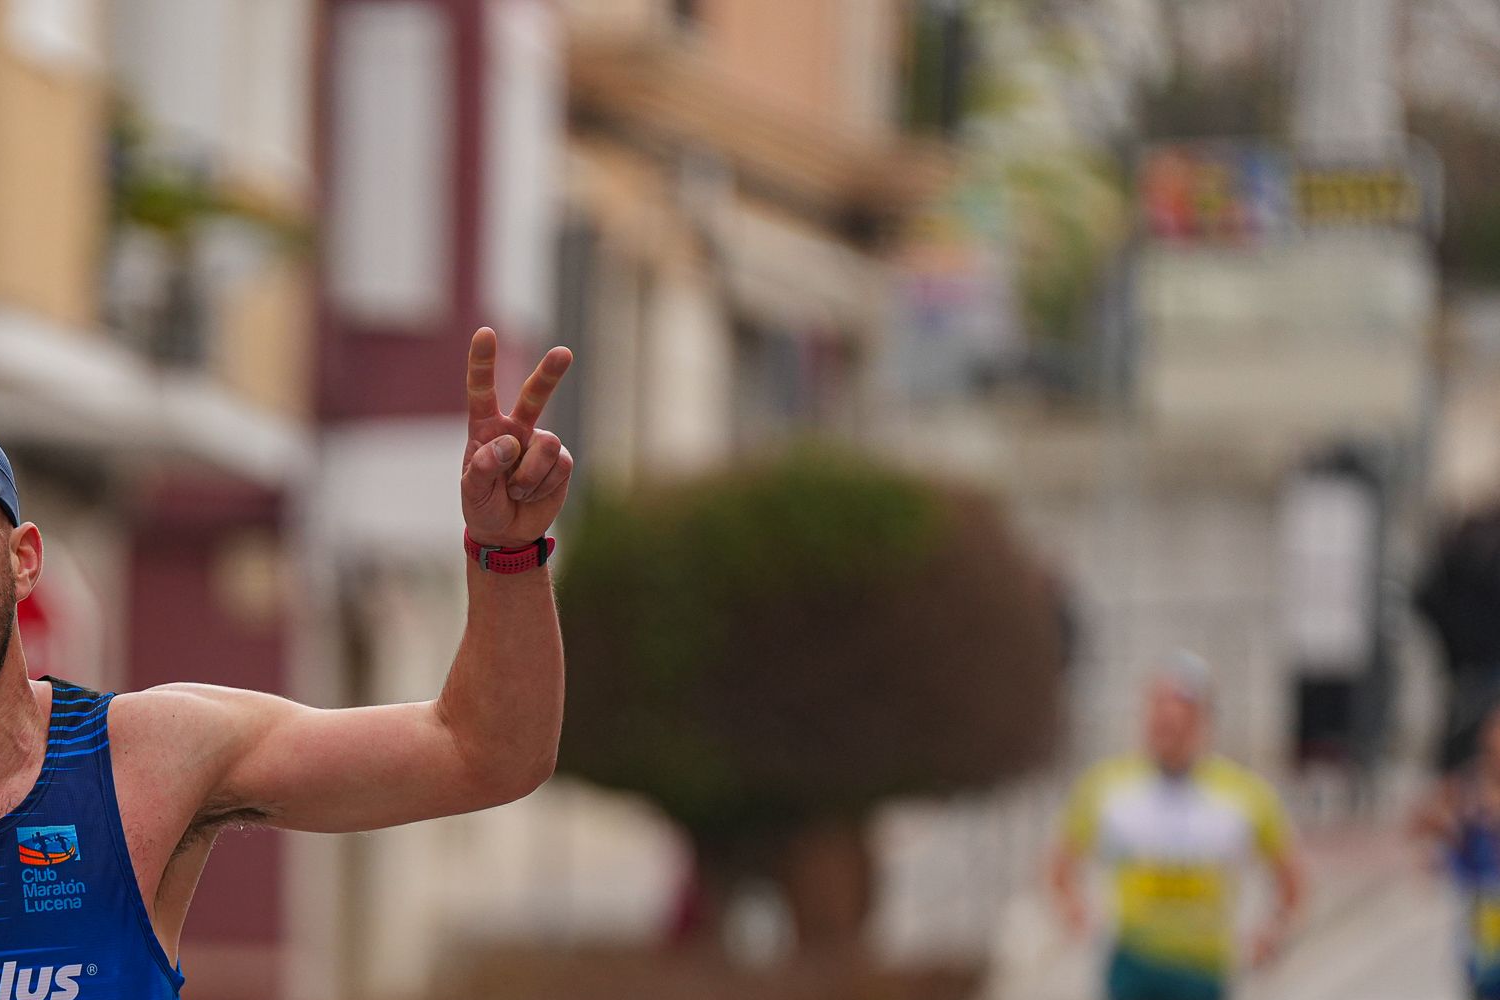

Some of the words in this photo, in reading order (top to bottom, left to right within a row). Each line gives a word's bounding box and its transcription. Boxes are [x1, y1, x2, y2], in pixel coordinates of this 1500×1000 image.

[22, 867, 57, 883] Club
[23, 878, 85, 898] Maratón
[24, 897, 82, 912] Lucena
